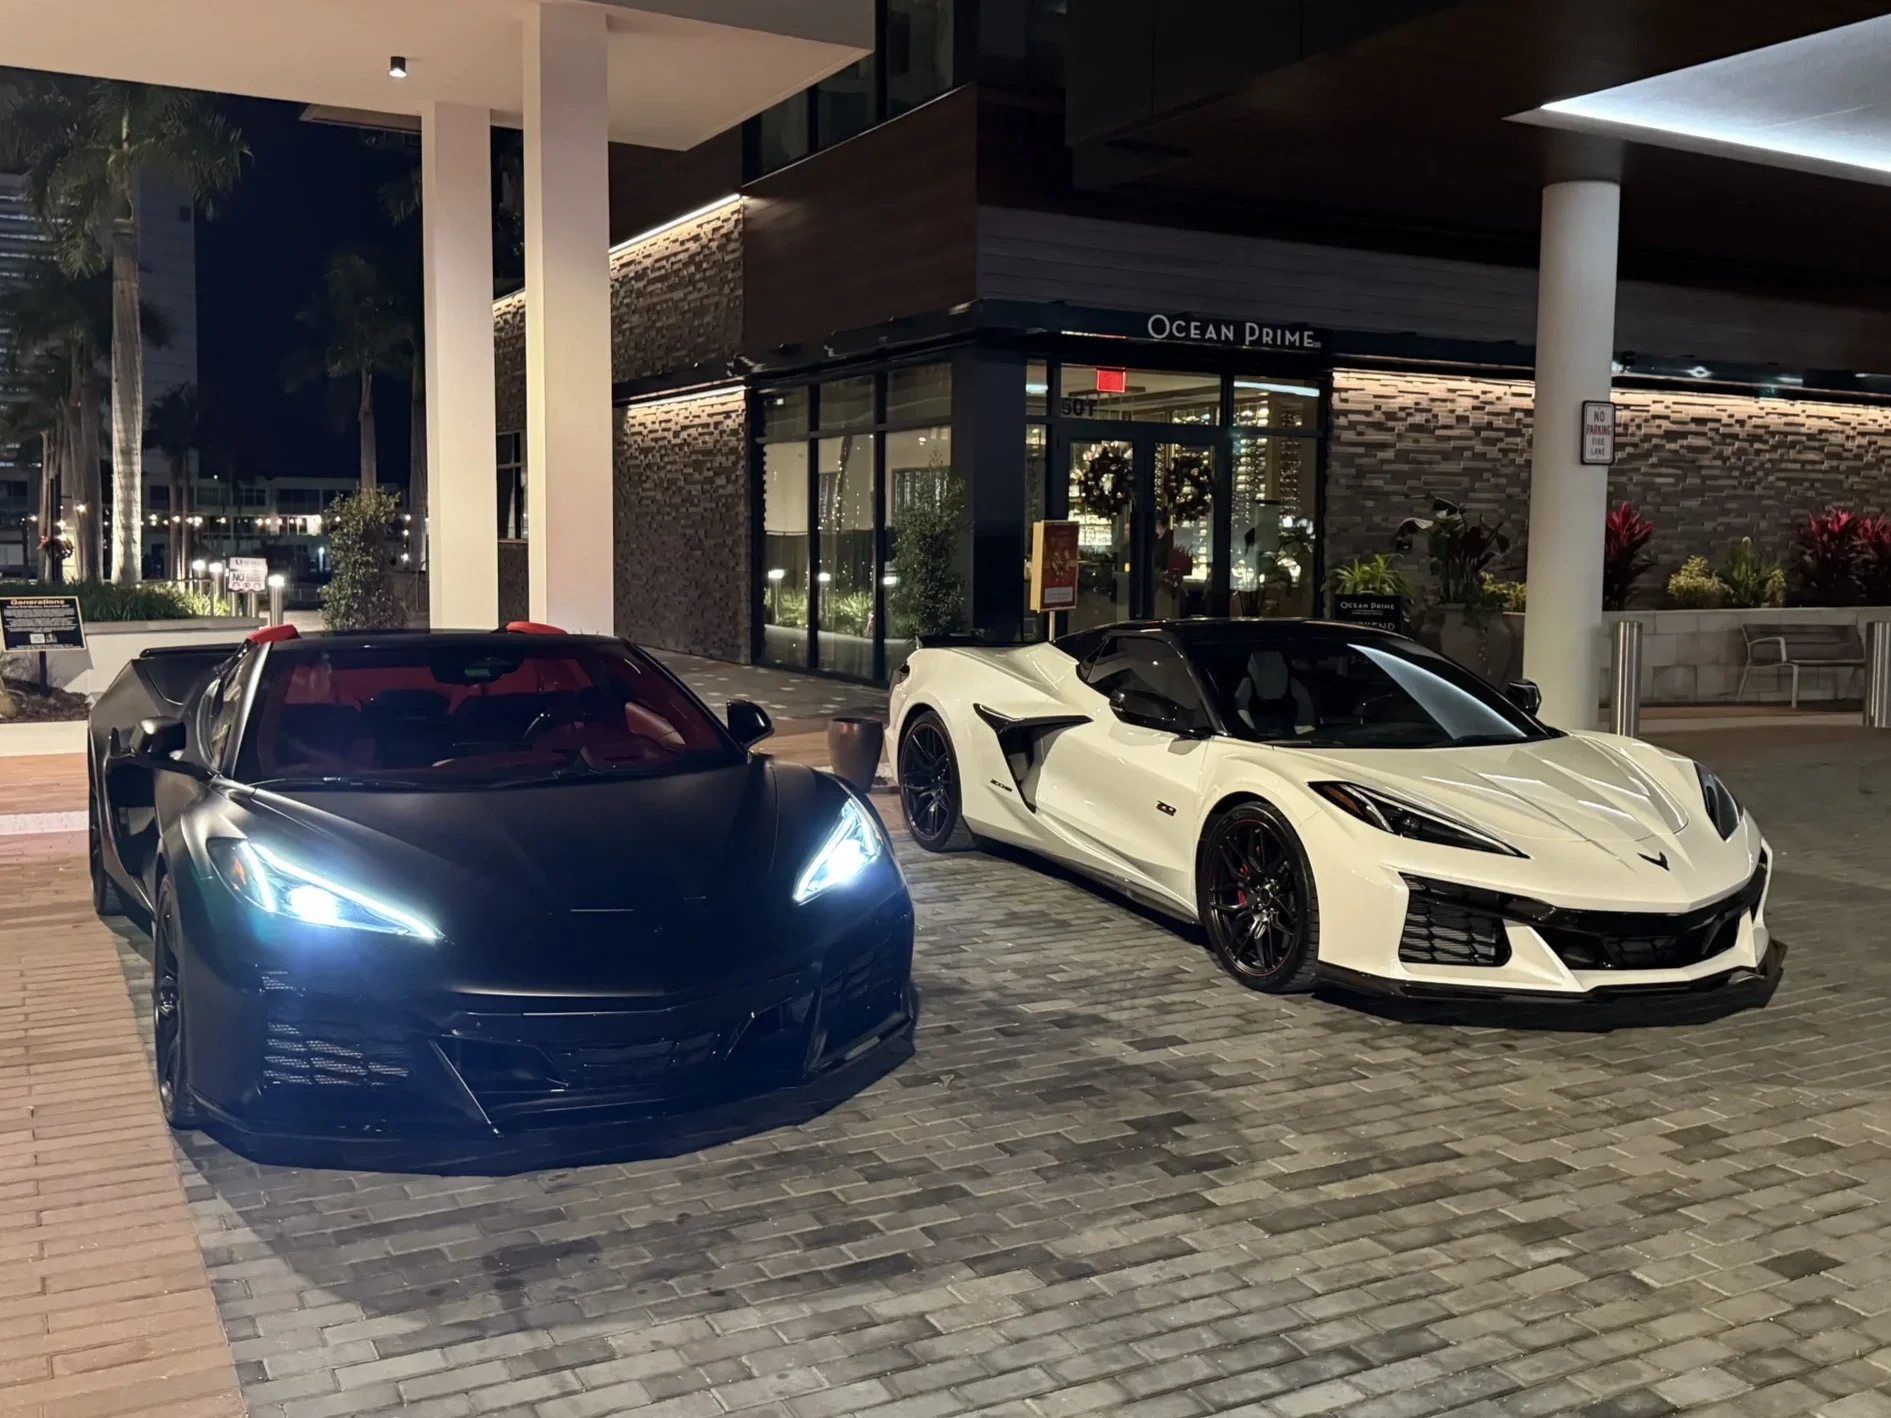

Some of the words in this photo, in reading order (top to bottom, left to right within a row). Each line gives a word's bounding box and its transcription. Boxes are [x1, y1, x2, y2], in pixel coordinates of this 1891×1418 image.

[1147, 314, 1234, 342] OCEAN
[1245, 322, 1314, 347] PRIME
[1594, 410, 1605, 422] NO
[1585, 424, 1611, 436] PARKING
[1592, 437, 1605, 446] FIRE
[1590, 447, 1605, 456] LANE
[232, 572, 245, 581] NO
[1340, 601, 1369, 610] OCEAN
[1370, 602, 1396, 610] PRIME
